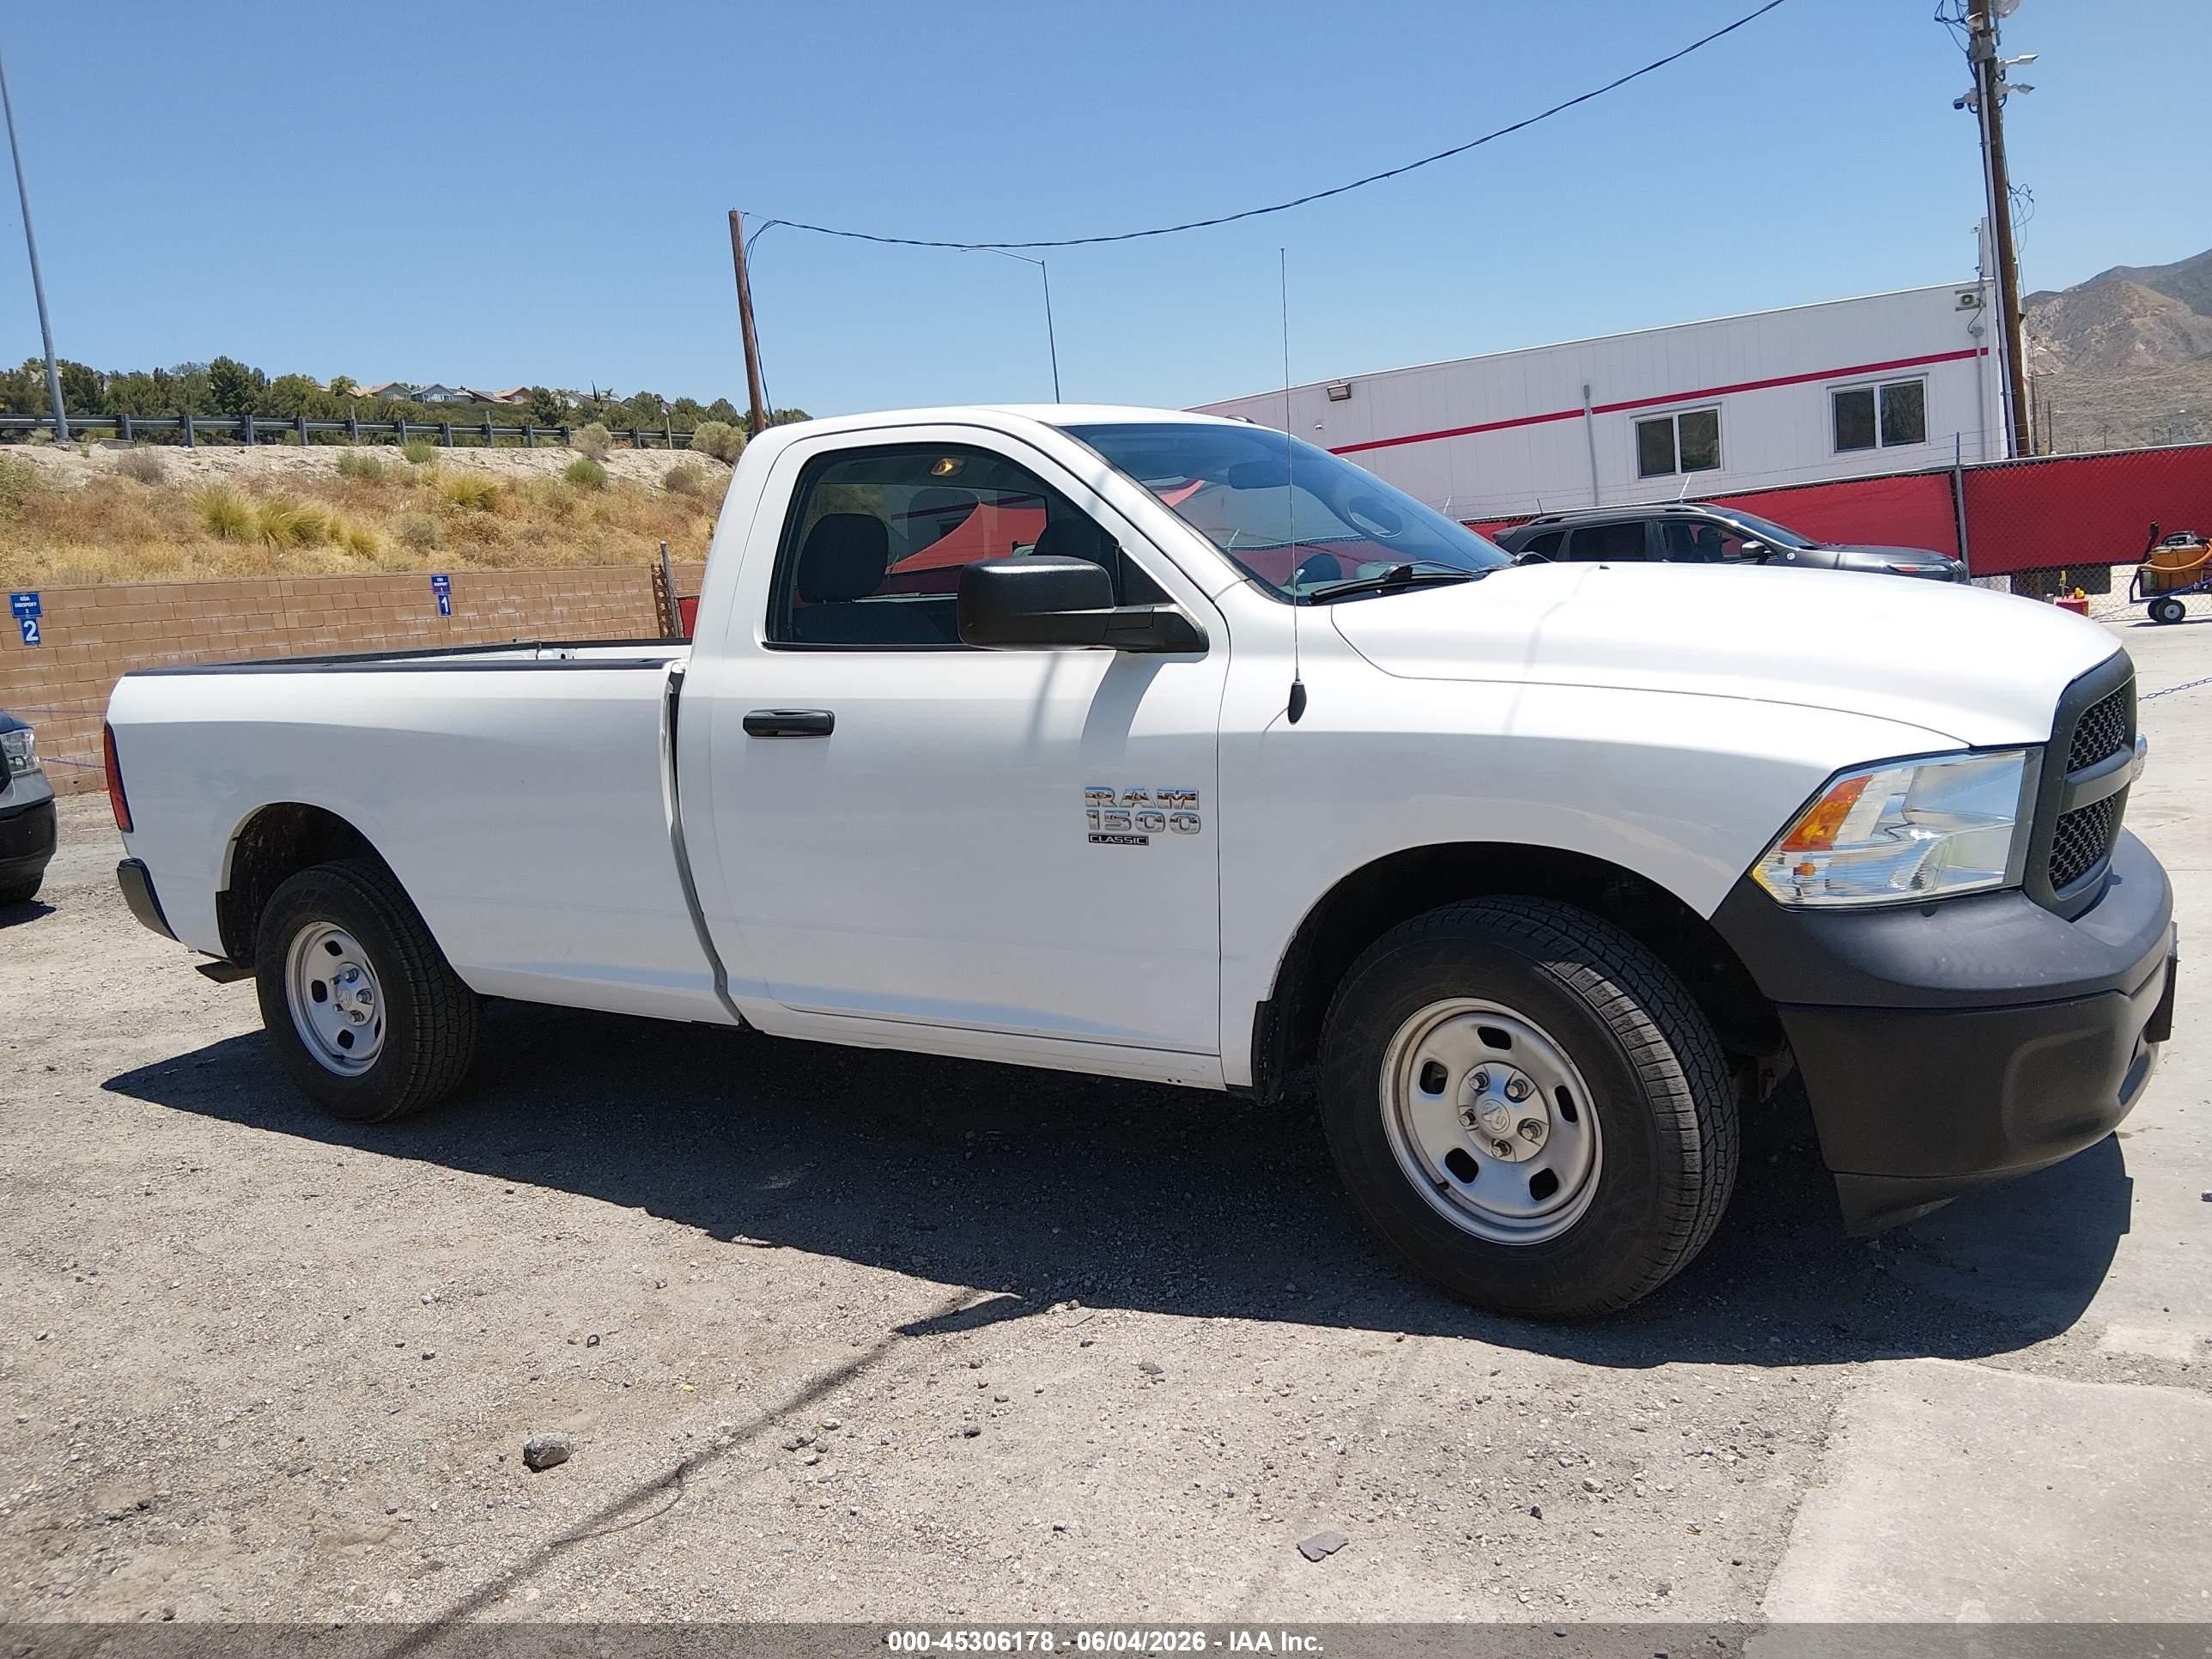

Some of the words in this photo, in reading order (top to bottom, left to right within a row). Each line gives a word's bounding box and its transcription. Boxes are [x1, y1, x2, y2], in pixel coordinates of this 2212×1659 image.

[441, 596, 449, 613] 1
[23, 620, 40, 641] 2
[1085, 787, 1199, 811] RAM
[1086, 810, 1201, 835] 1500
[1089, 835, 1146, 845] CLASSIC
